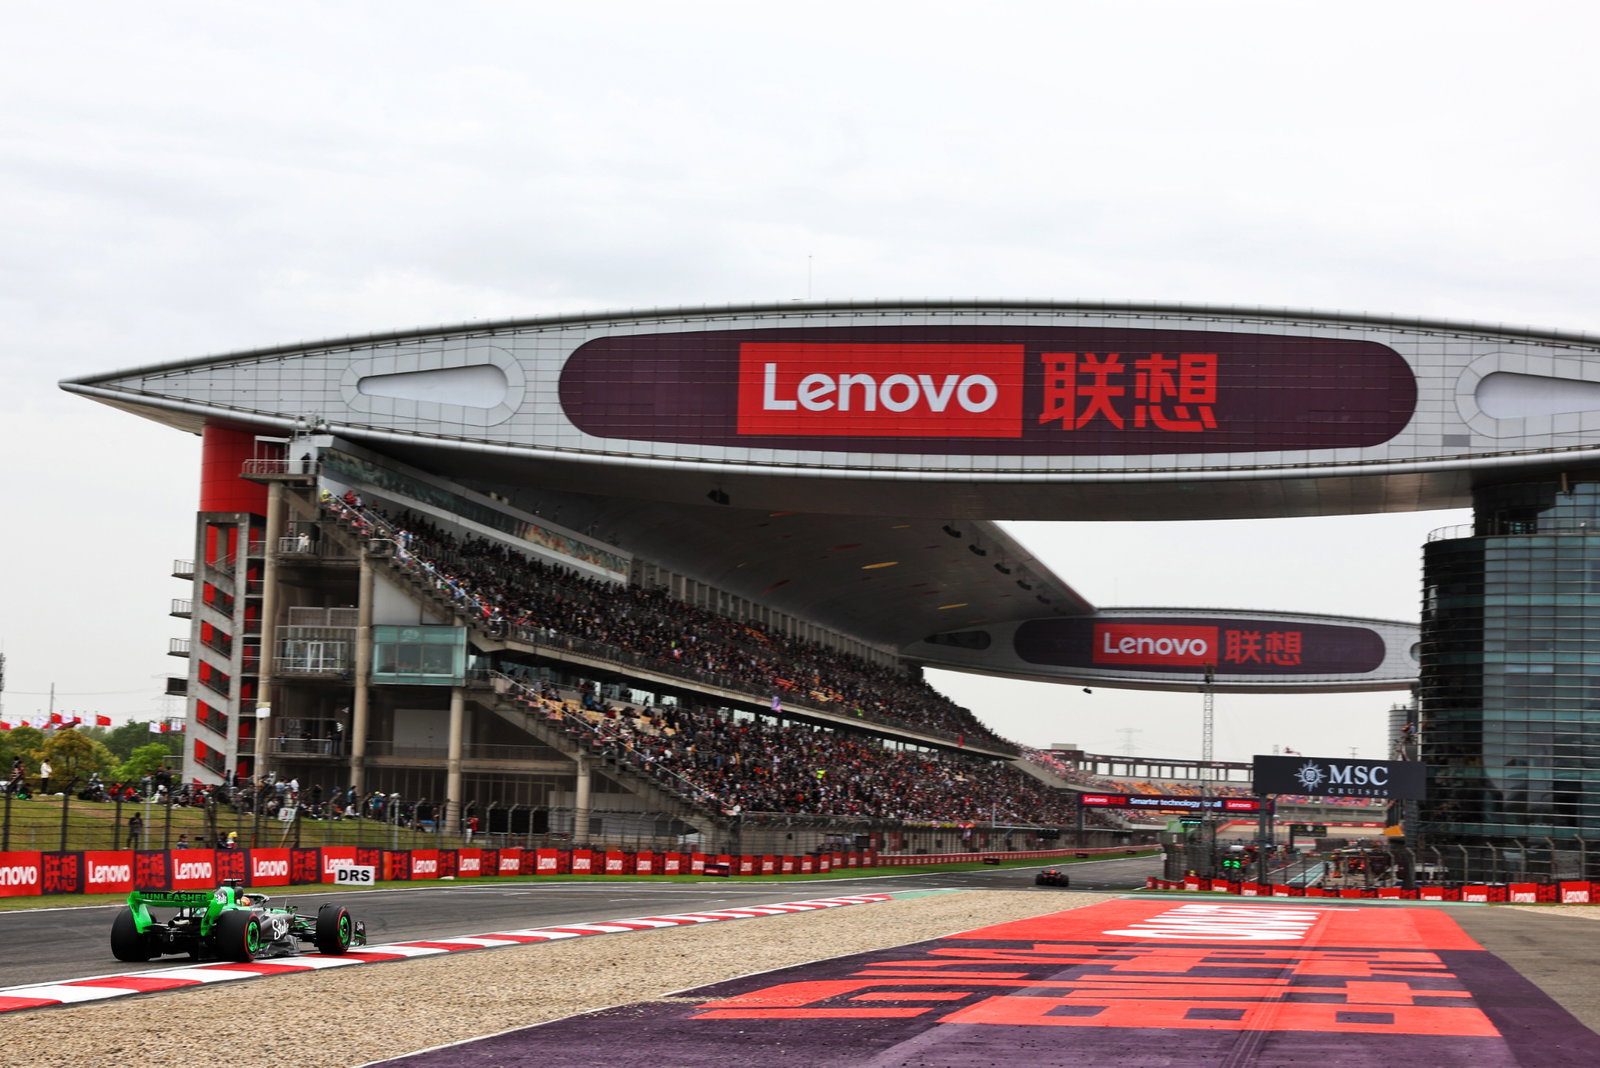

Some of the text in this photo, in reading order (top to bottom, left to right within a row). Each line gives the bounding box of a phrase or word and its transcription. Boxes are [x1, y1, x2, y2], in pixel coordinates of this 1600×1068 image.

[763, 362, 998, 413] Lenovo
[1039, 352, 1219, 433] 联想
[1103, 632, 1208, 656] Lenovo
[1225, 630, 1303, 666] 联想
[1328, 765, 1388, 785] MSC
[1328, 787, 1388, 796] CRUISES
[1130, 797, 1158, 805] Smarter
[1160, 799, 1200, 808] technology
[88, 861, 130, 883] Lenovo
[174, 859, 212, 879] Lenovo
[253, 857, 288, 877] Lenovo
[338, 869, 370, 882] DRS
